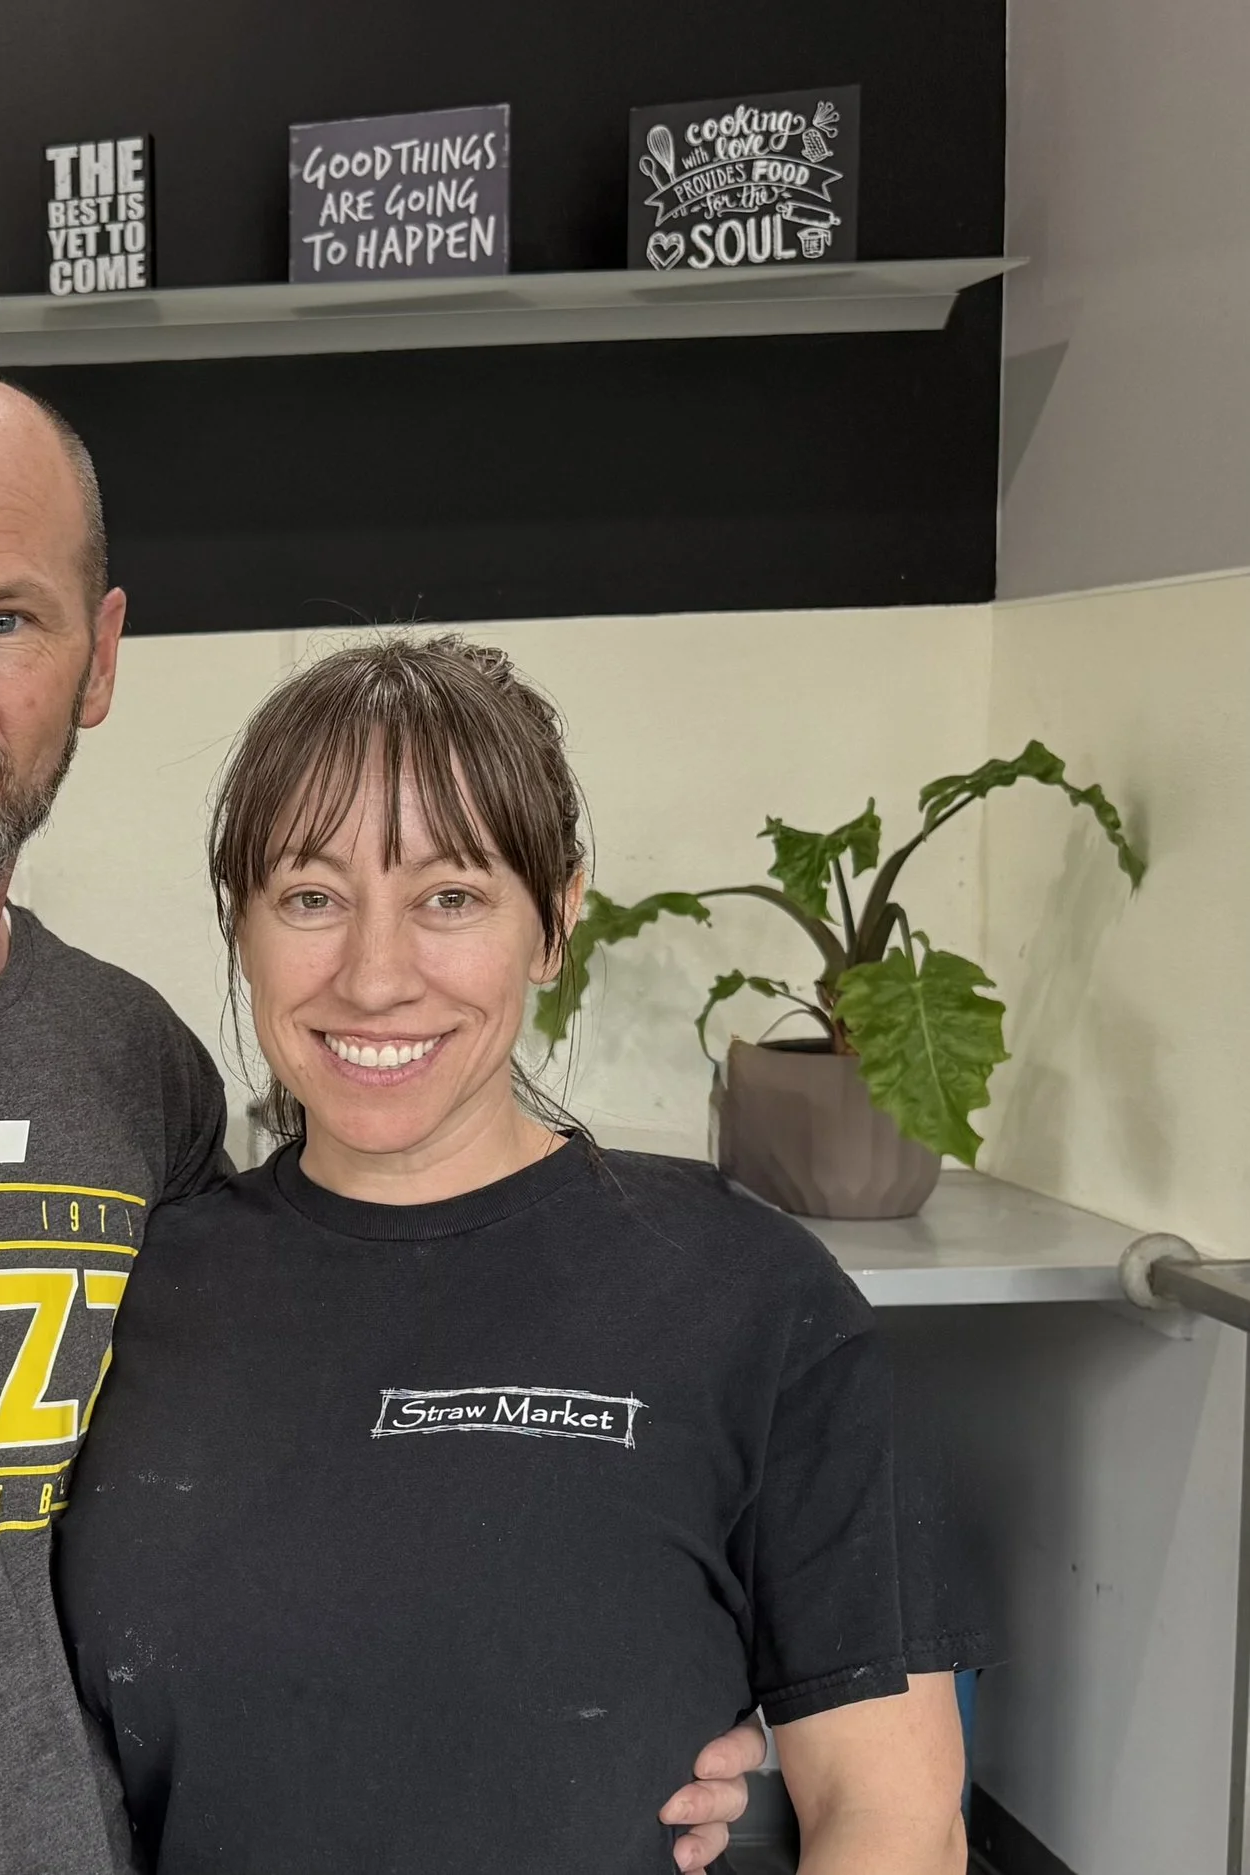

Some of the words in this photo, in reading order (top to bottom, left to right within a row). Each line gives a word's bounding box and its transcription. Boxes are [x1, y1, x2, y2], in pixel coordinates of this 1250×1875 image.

[686, 104, 806, 151] cooking
[46, 137, 144, 200] THE
[301, 145, 392, 189] GOOD
[390, 132, 497, 177] THINGS
[681, 146, 710, 170] with
[714, 133, 768, 160] love
[319, 191, 375, 226] ARE
[385, 178, 478, 221] GOING
[673, 163, 748, 203] PROVIDES
[751, 160, 810, 186] FOOD
[48, 196, 114, 229] BEST
[117, 193, 145, 222] IS
[47, 226, 99, 260] YET
[105, 221, 145, 254] TO
[302, 231, 347, 272] TO
[355, 216, 496, 269] HAPPEN
[687, 213, 797, 269] SOUL
[50, 254, 146, 297] COME
[392, 1400, 487, 1428] Straw
[493, 1396, 614, 1430] Market
